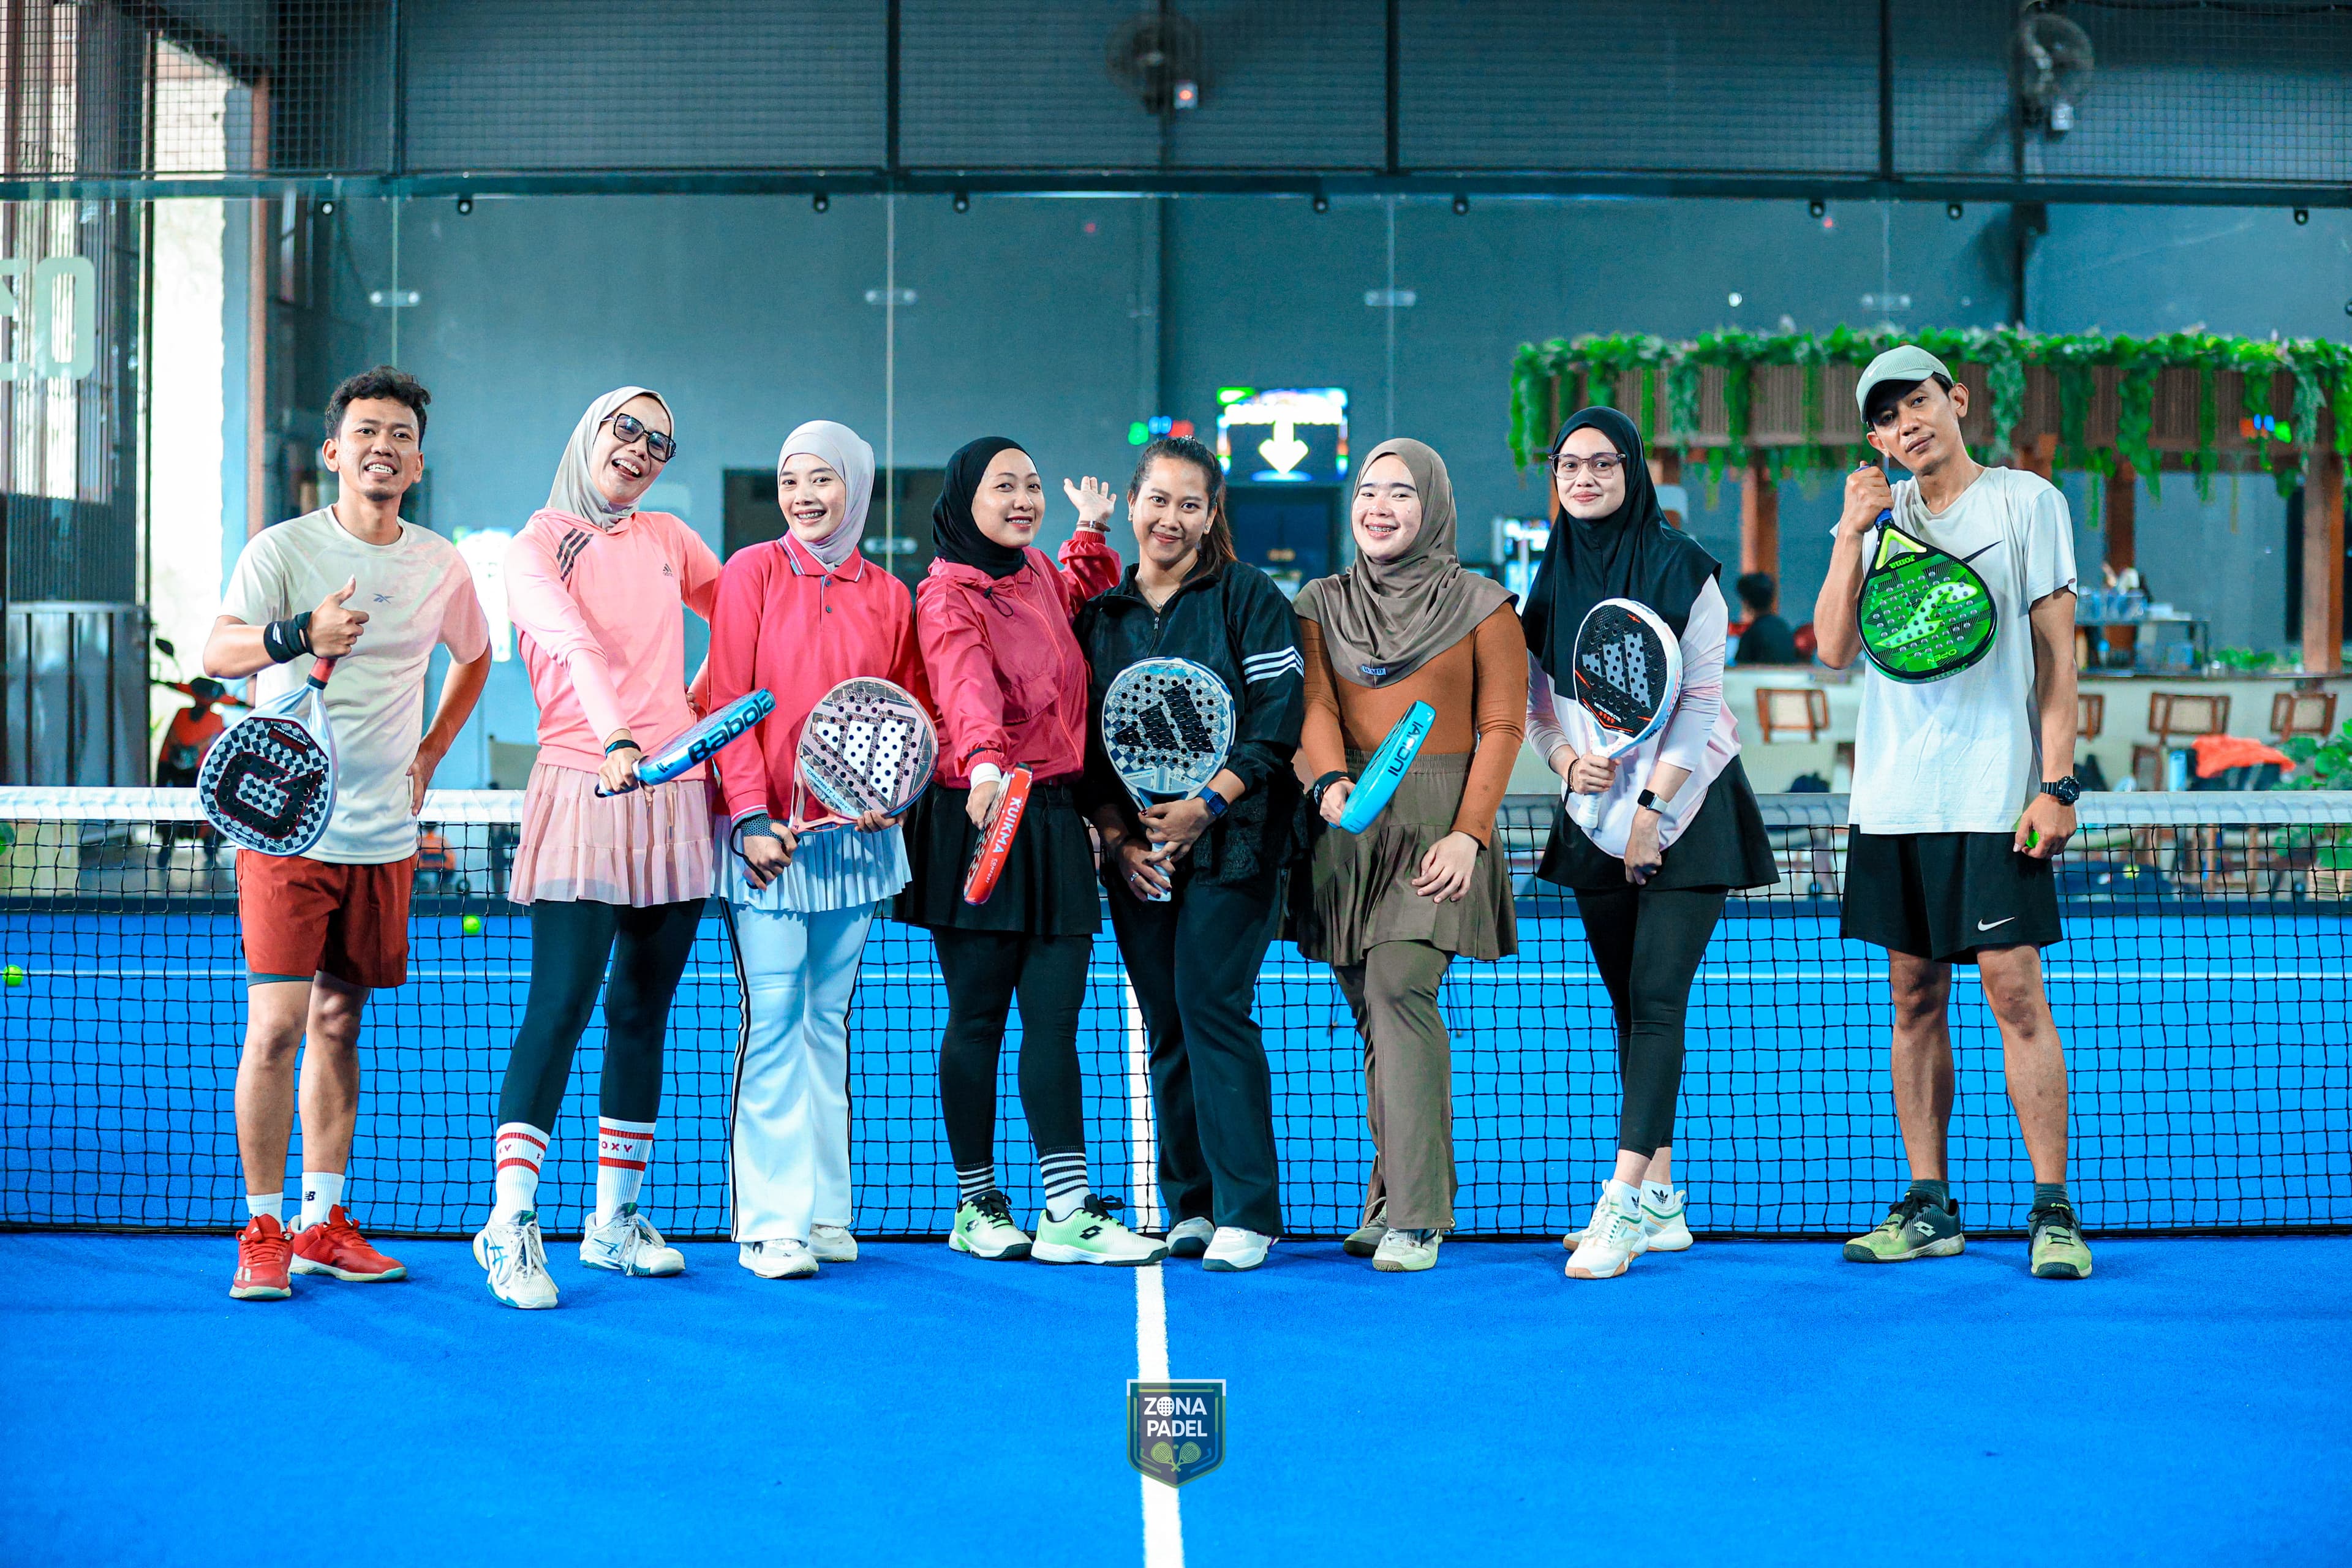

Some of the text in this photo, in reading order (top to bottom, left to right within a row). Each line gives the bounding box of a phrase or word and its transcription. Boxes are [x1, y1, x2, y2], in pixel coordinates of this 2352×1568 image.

[1888, 554, 1915, 568] Joma
[1927, 649, 1957, 665] OPEN
[992, 797, 1022, 853] KUIKMA
[599, 1140, 633, 1153] OXY
